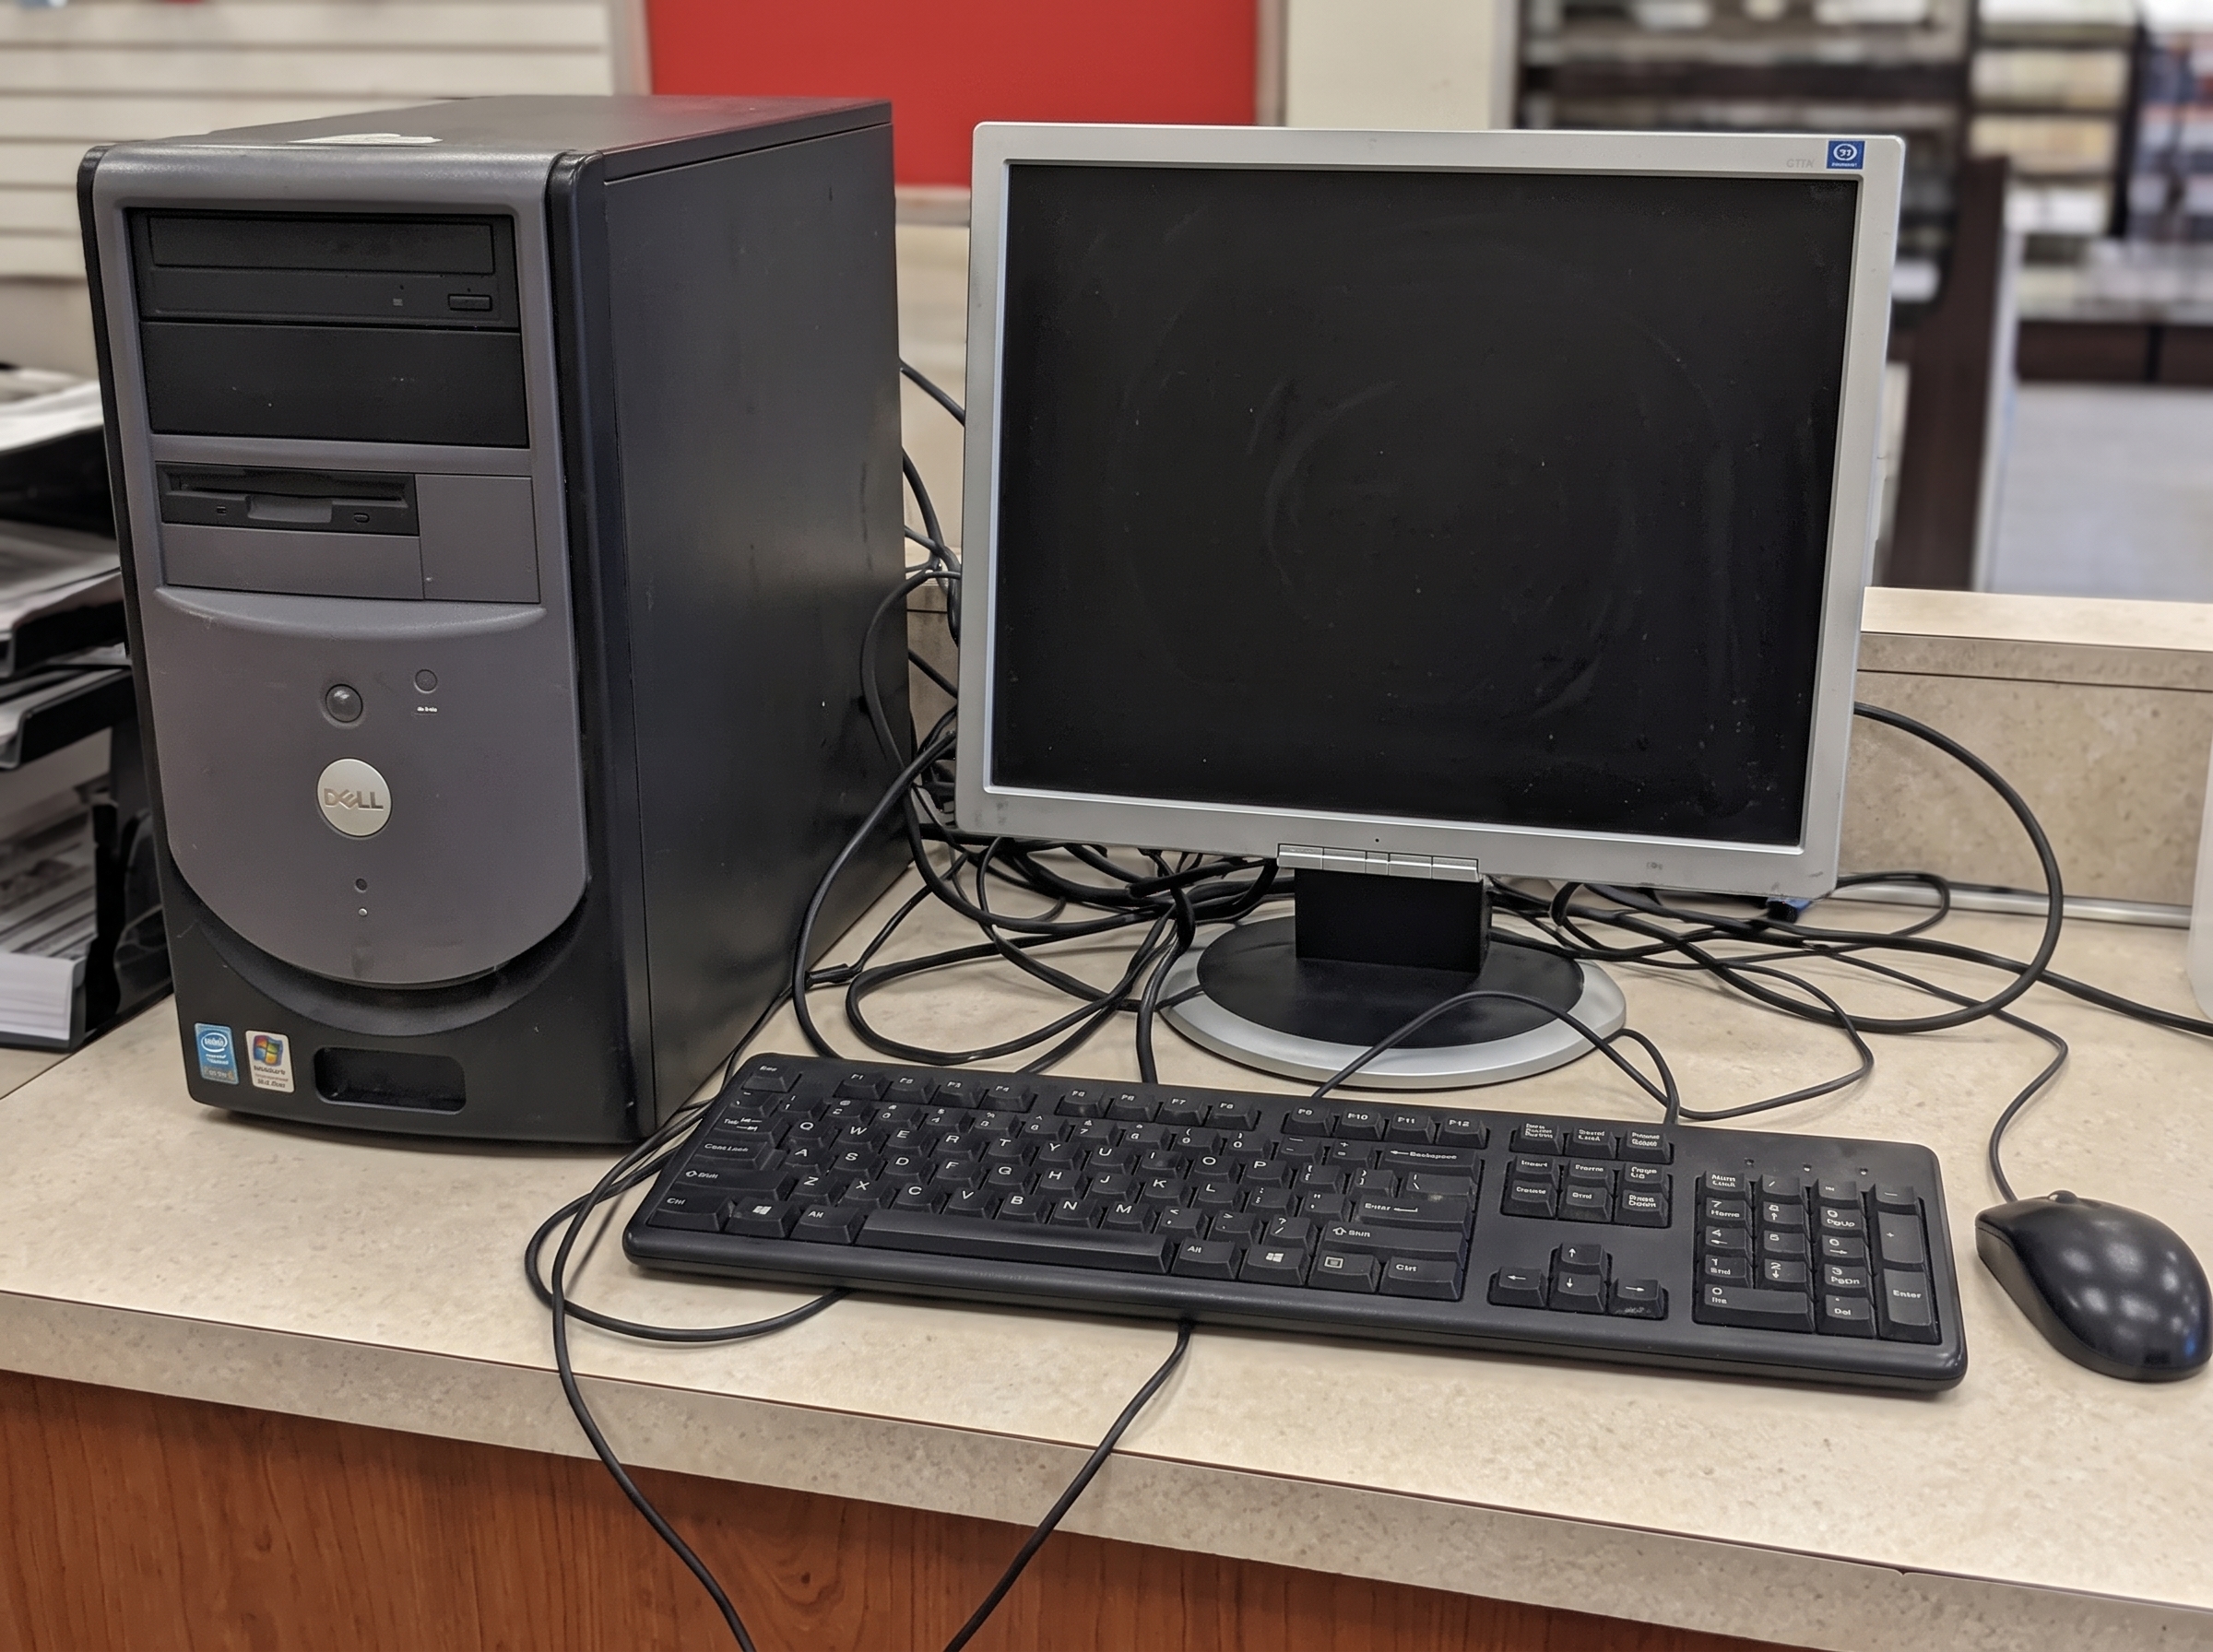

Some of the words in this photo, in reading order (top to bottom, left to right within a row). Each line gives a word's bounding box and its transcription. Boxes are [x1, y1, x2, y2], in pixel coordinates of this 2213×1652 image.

[324, 788, 384, 810] DELL
[800, 1122, 813, 1130] Q
[851, 1127, 867, 1135] W
[1099, 1148, 1112, 1156] U
[1049, 1171, 1061, 1179] H
[804, 1176, 818, 1186] Z
[1154, 1179, 1166, 1187] K
[856, 1181, 870, 1190] X
[1206, 1184, 1215, 1192] L
[909, 1186, 921, 1195] C
[963, 1191, 974, 1199] V
[1011, 1196, 1024, 1204] B
[1063, 1201, 1077, 1210] N
[1116, 1205, 1131, 1213] M
[1893, 1290, 1921, 1298] Enter
